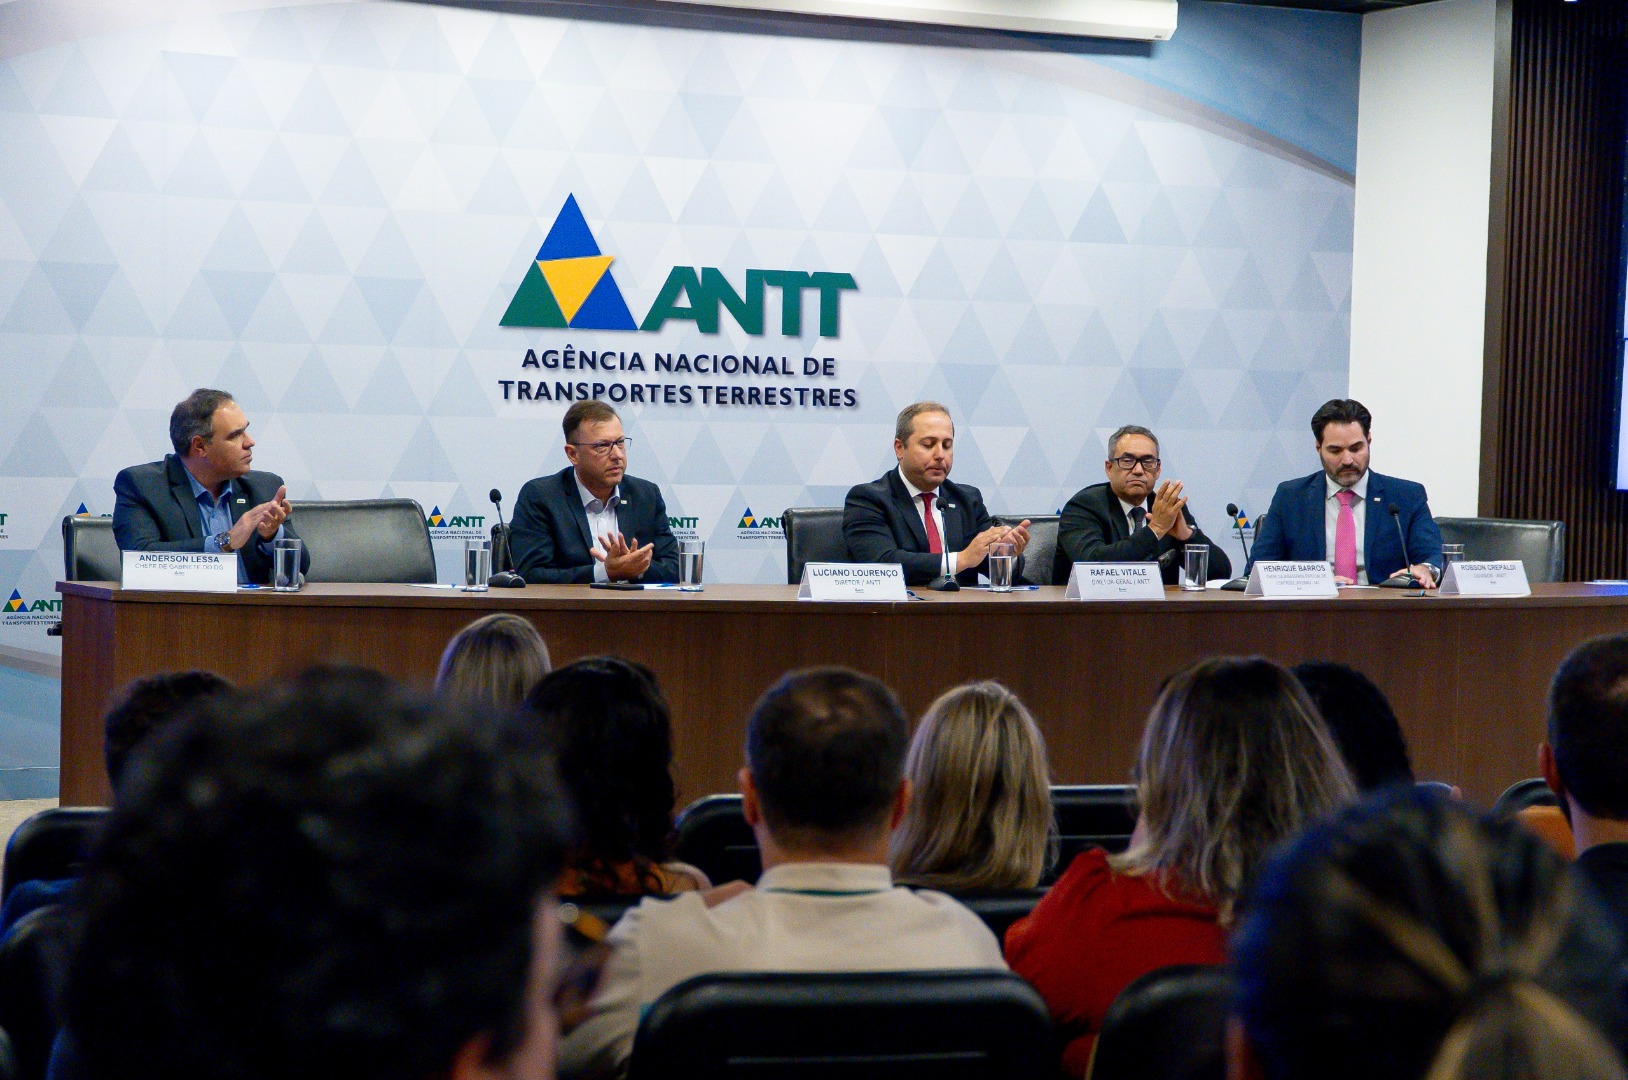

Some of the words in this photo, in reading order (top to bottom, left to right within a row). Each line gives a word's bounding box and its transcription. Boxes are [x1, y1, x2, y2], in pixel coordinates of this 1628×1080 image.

[639, 265, 858, 337] ANTT
[521, 344, 645, 372] AGÊNCIA
[654, 352, 794, 376] NACIONAL
[802, 357, 835, 376] DE
[498, 380, 692, 404] TRANSPORTES
[697, 385, 857, 407] TERRESTRES
[448, 516, 485, 527] ANTT
[759, 517, 782, 528] AN
[139, 554, 189, 563] ANDERSON
[191, 555, 220, 564] LESSA
[812, 568, 850, 577] LUCIANO
[852, 569, 898, 578] LOURENÇO
[1090, 568, 1120, 576] RAFAEL
[1120, 568, 1147, 576] VITALE
[1297, 564, 1326, 572] BARROS
[1091, 578, 1132, 586] DIRETOR-GERAL
[29, 600, 62, 612] ANT
